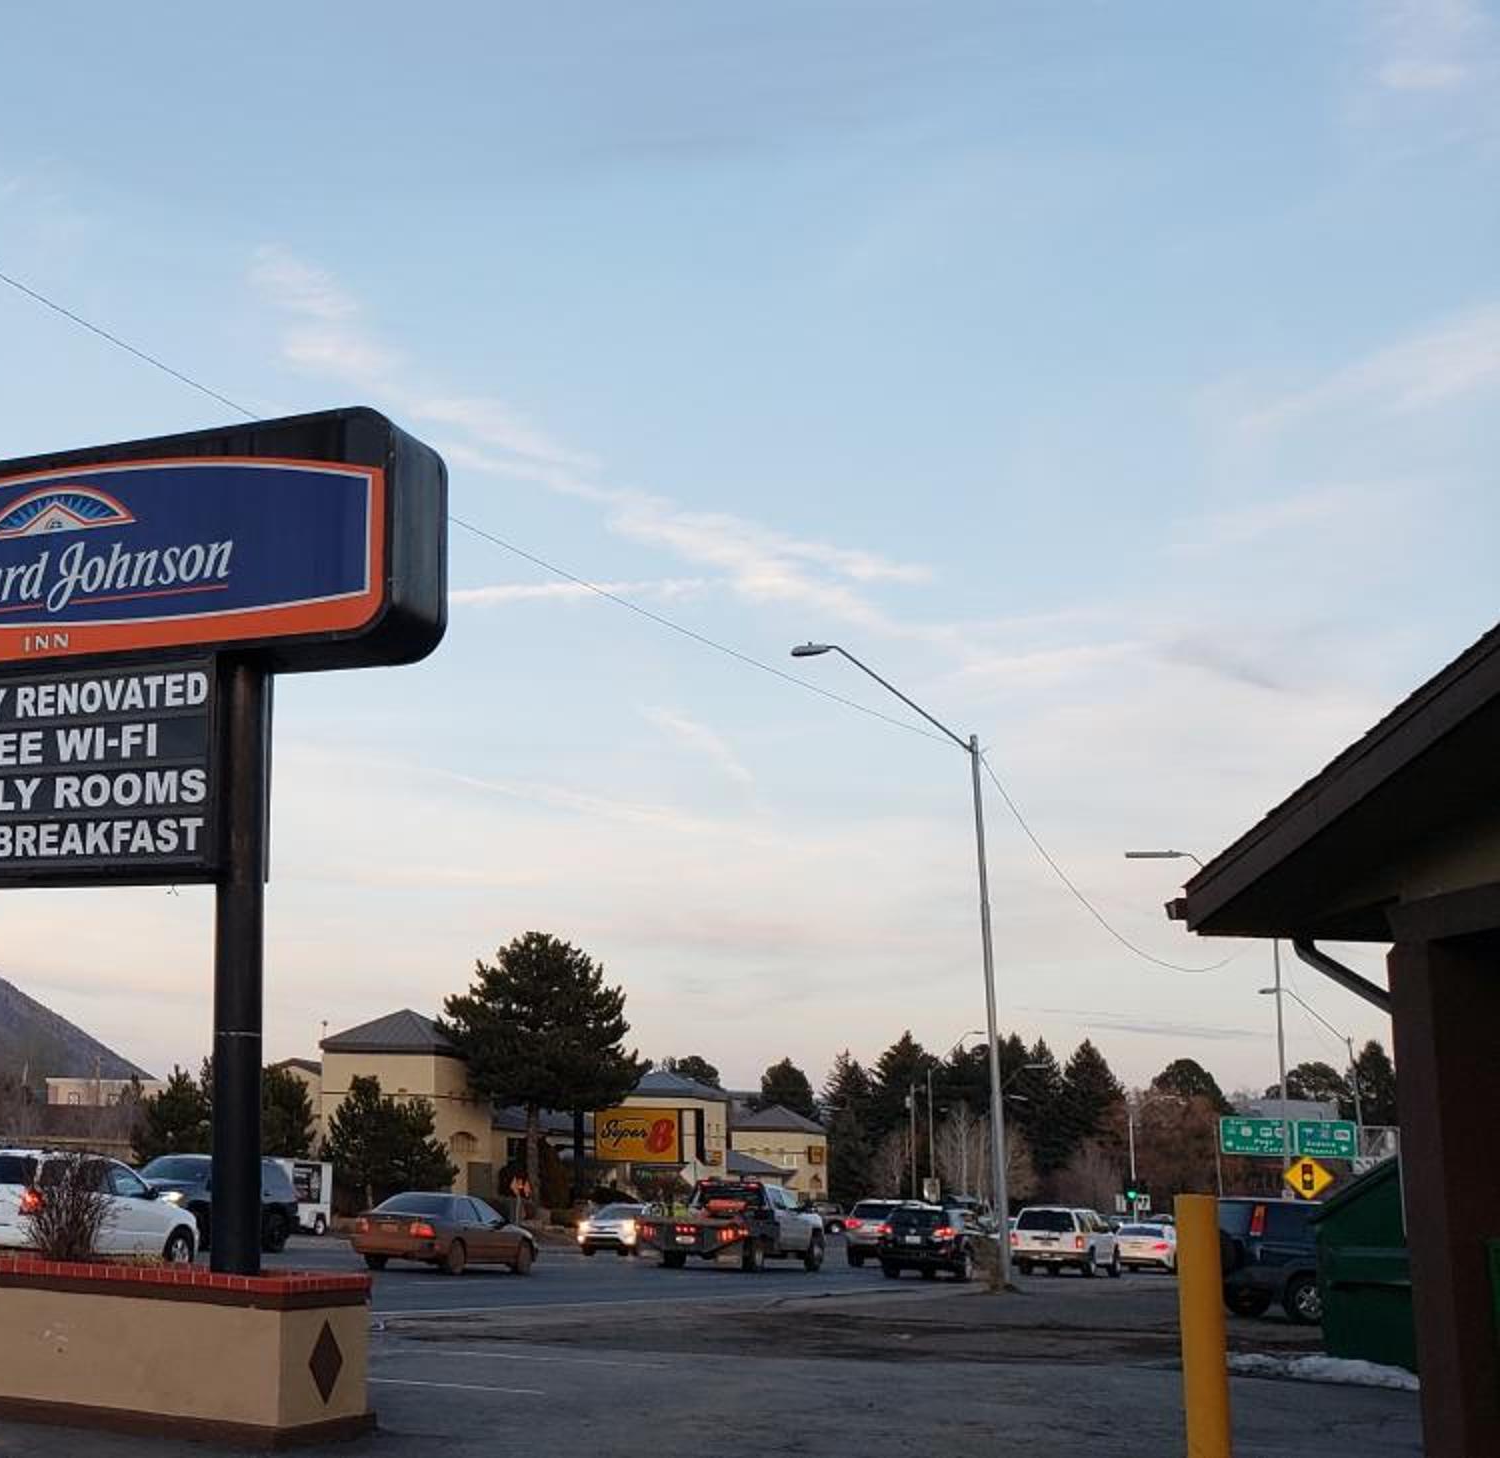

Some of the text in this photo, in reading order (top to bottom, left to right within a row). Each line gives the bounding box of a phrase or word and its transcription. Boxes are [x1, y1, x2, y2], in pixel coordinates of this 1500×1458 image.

[47, 540, 233, 611] Johnson
[23, 633, 68, 651] INN
[17, 672, 208, 717] RENOVATED
[57, 723, 157, 762] WI-FI
[54, 770, 206, 809] ROOMS
[600, 1119, 674, 1153] Super 8
